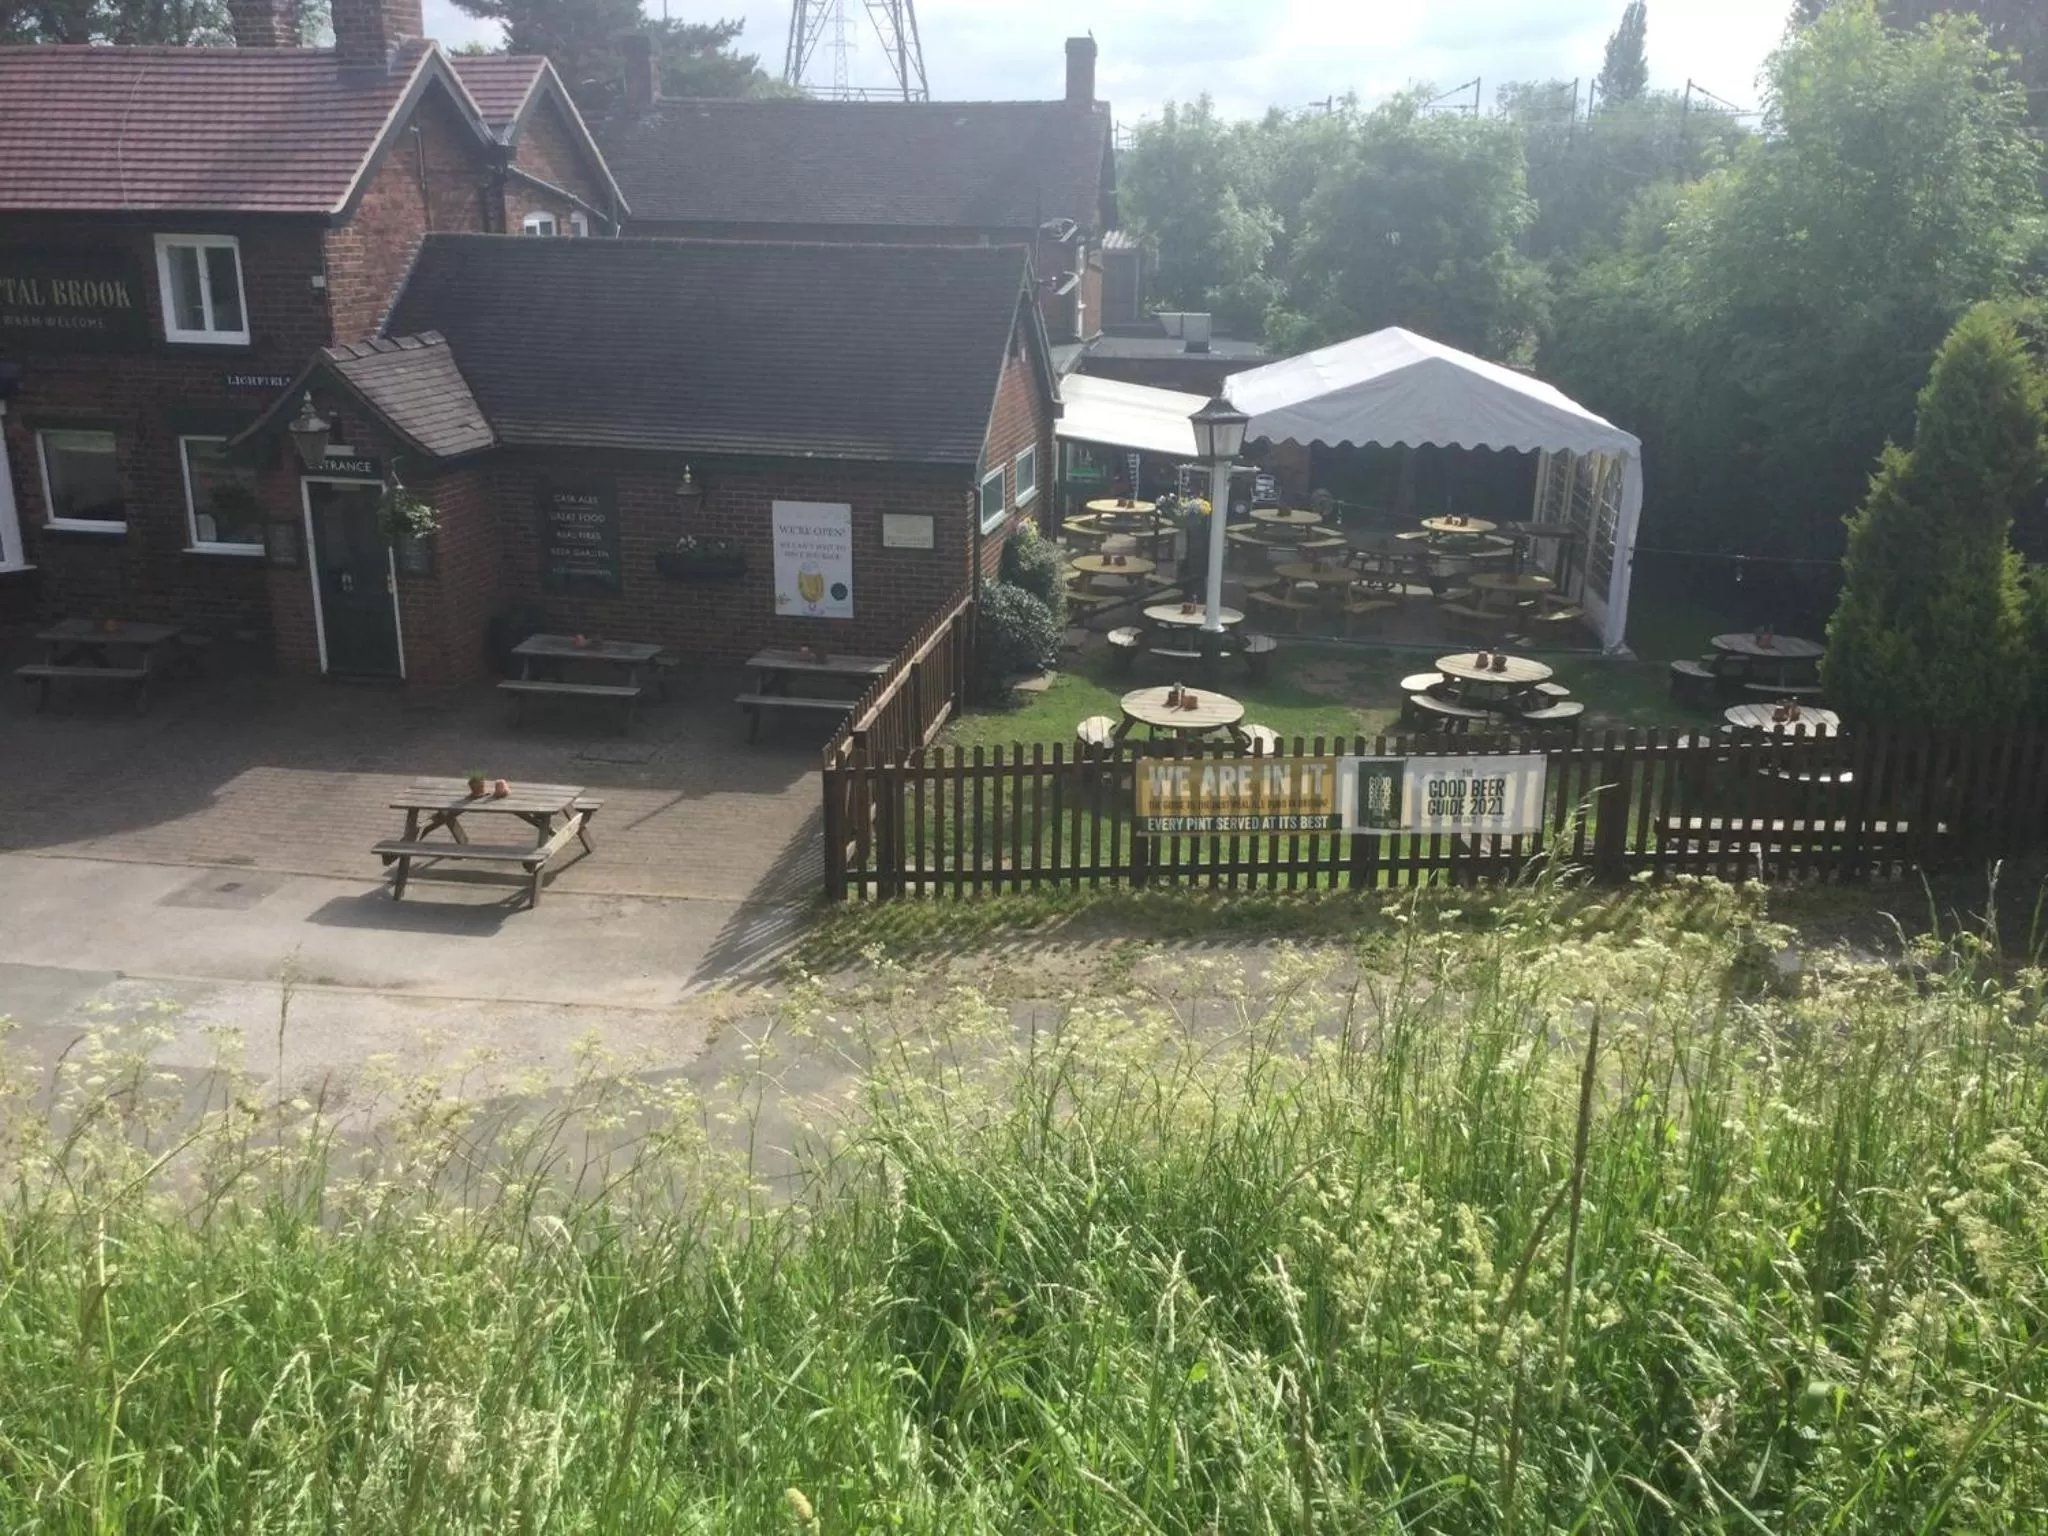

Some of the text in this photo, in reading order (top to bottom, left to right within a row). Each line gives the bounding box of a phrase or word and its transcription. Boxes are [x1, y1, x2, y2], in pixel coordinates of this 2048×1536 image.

[0, 278, 132, 308] TAL BROOK
[45, 316, 106, 329] WELCOME
[306, 459, 373, 473] TRANCE
[579, 513, 606, 523] FOOD
[1149, 763, 1328, 797] WE ARE IN IT
[1429, 779, 1505, 798] GOOD BEER
[1428, 797, 1505, 816] GUIDE 2021
[1148, 815, 1328, 831] EVERY PINT SERVED AT ITS BEST
